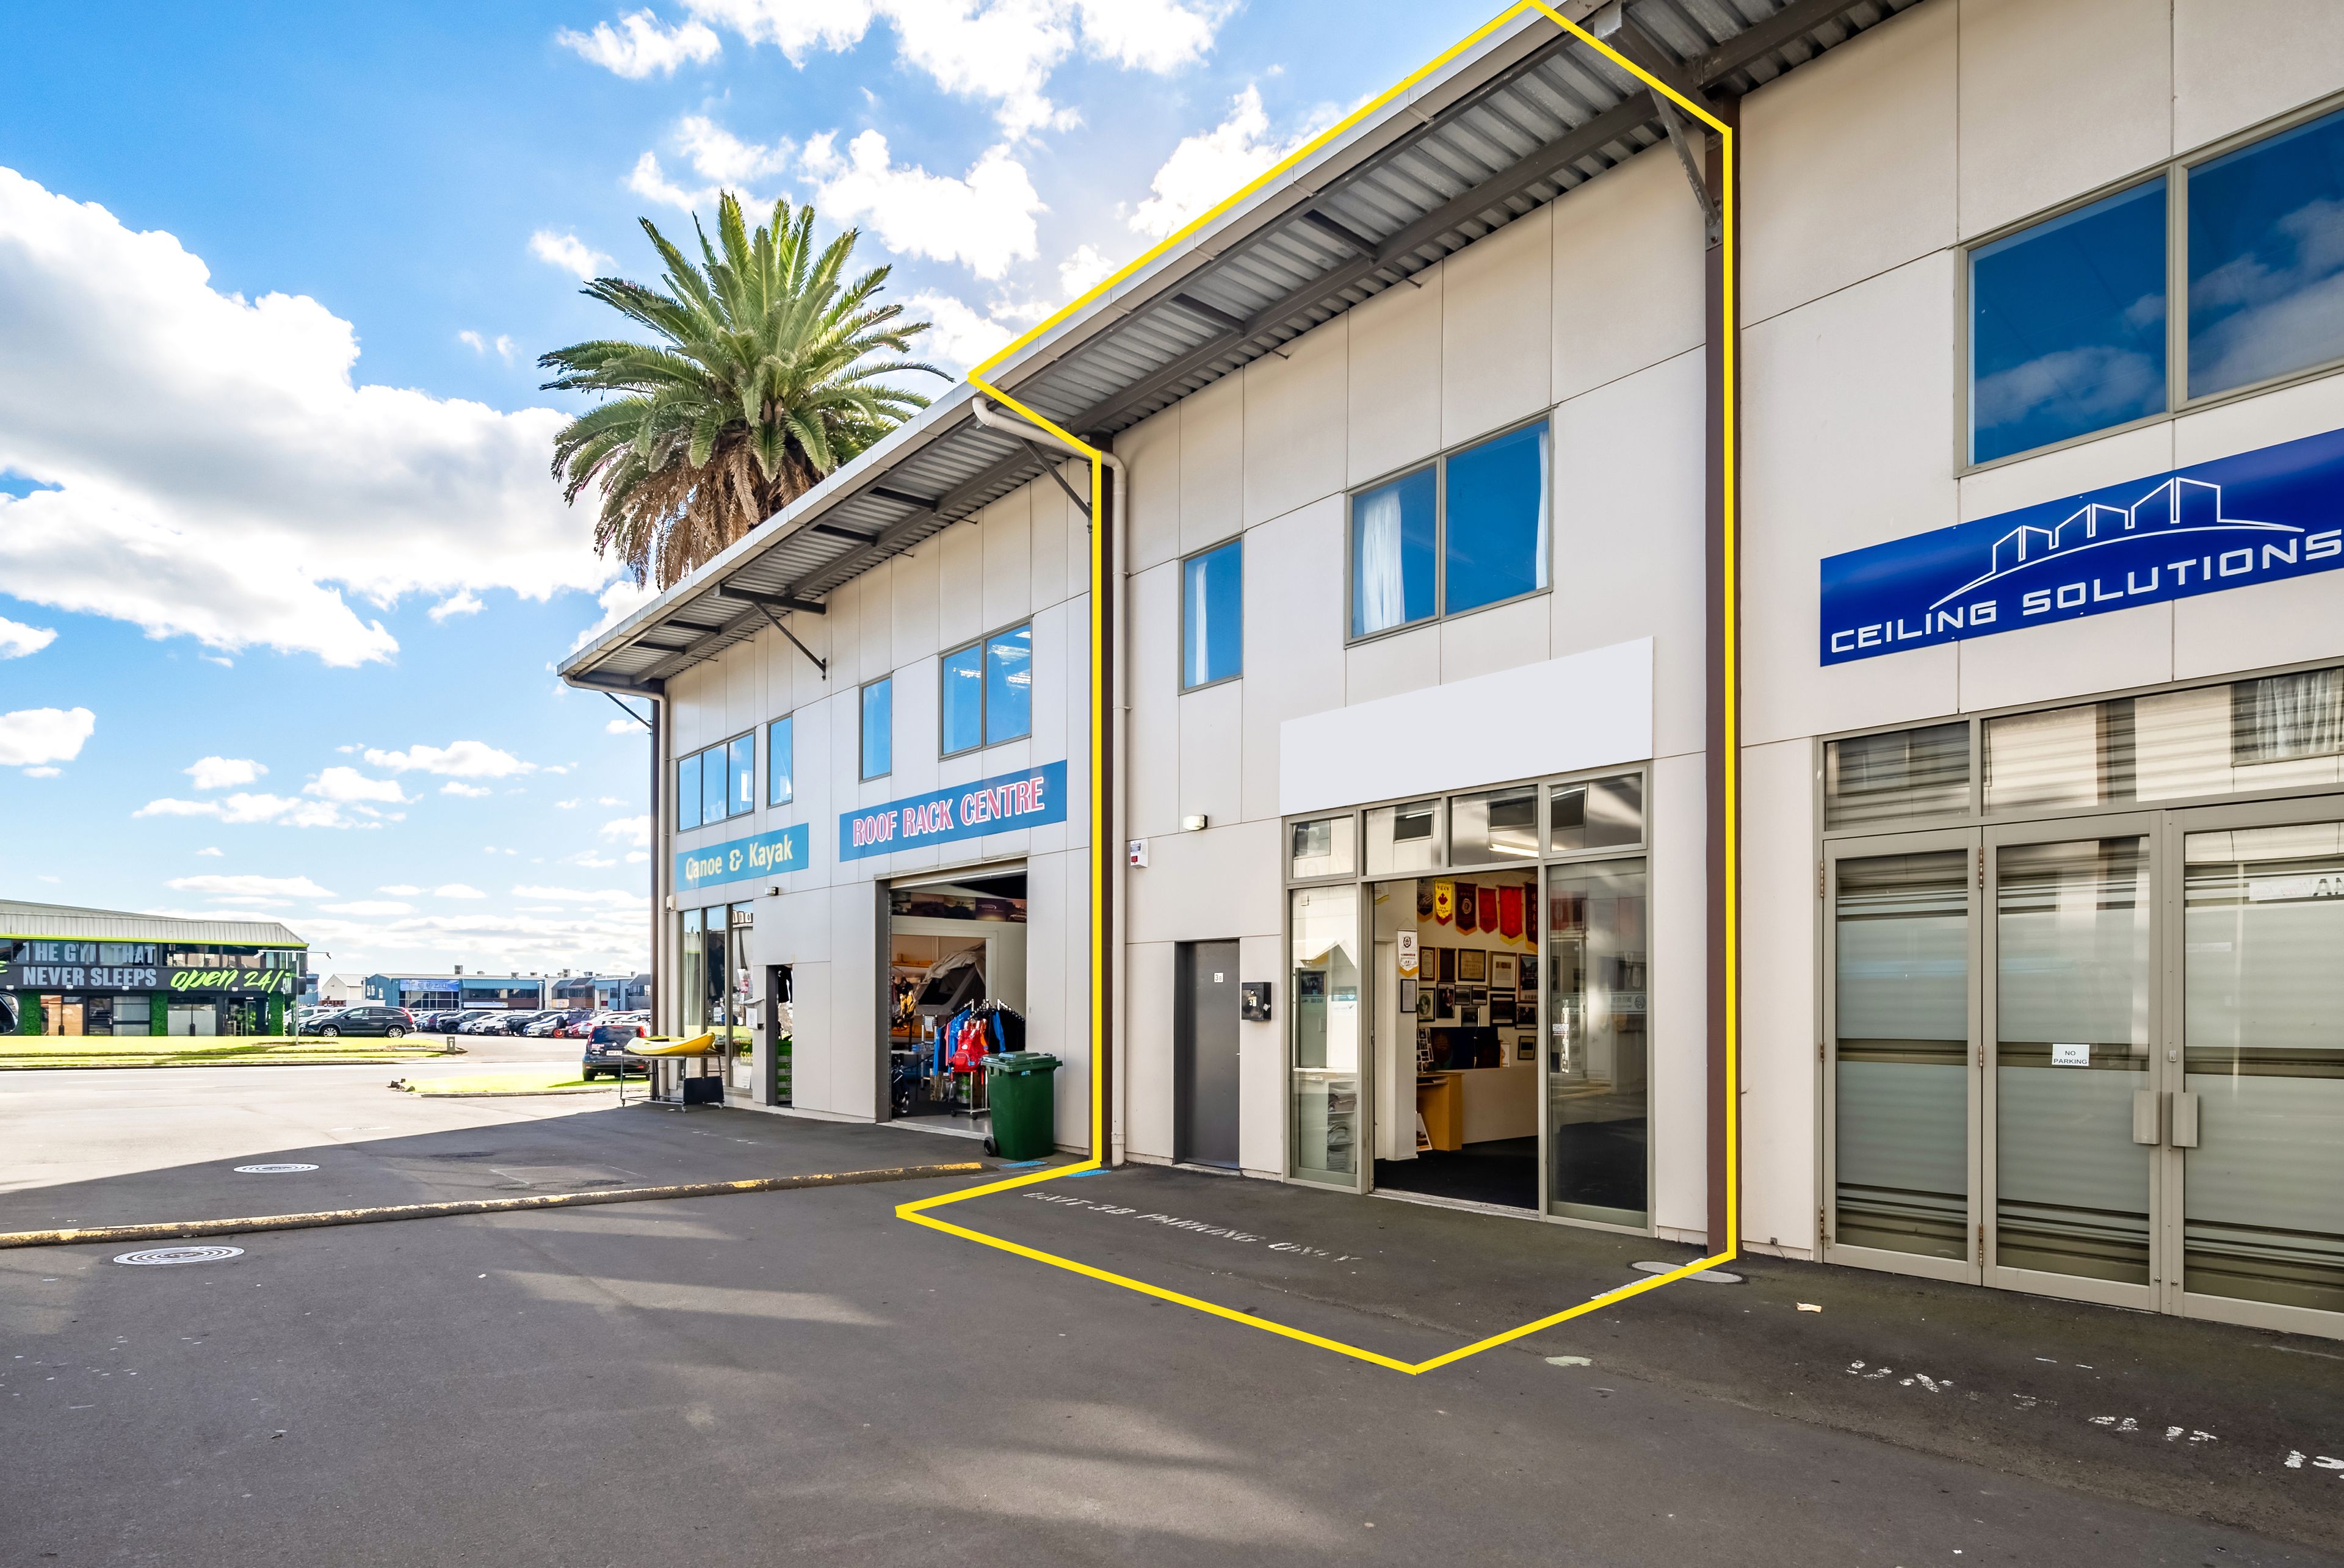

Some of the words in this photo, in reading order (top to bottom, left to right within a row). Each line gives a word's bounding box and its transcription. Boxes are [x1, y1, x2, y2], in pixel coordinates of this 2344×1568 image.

[1831, 599, 1997, 653] CEILING
[2022, 529, 2343, 616] SOLUTIONS
[853, 810, 897, 847] ROOF
[903, 798, 954, 837] RACK
[960, 776, 1044, 826] CENTRE
[685, 856, 722, 880] Canoe
[729, 849, 743, 872] &
[749, 834, 793, 872] Kayak
[23, 942, 59, 962] THE
[64, 944, 105, 963] GYM
[112, 945, 156, 964] THAT
[23, 966, 85, 986] NEVER
[90, 967, 157, 987] SLEEPS
[170, 969, 239, 992] open
[1134, 1213, 1267, 1243] PARKING
